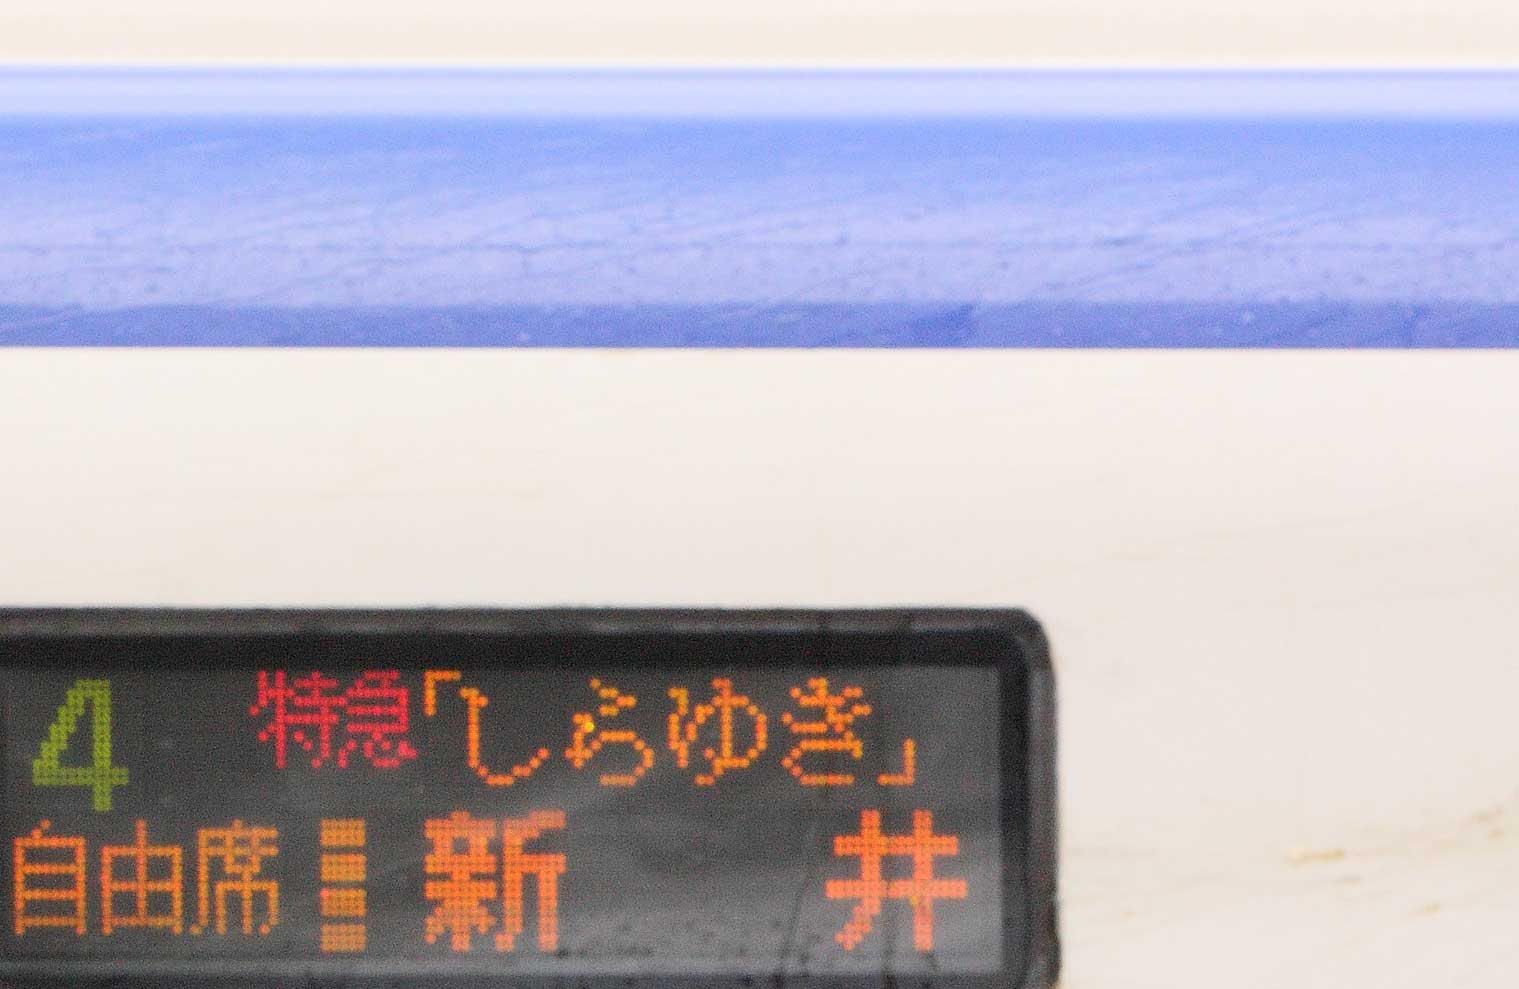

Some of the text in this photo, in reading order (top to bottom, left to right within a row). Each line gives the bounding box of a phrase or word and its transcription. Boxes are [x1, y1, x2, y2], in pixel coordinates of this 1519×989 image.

[33, 680, 128, 811] 4
[11, 818, 281, 936] 自由席
